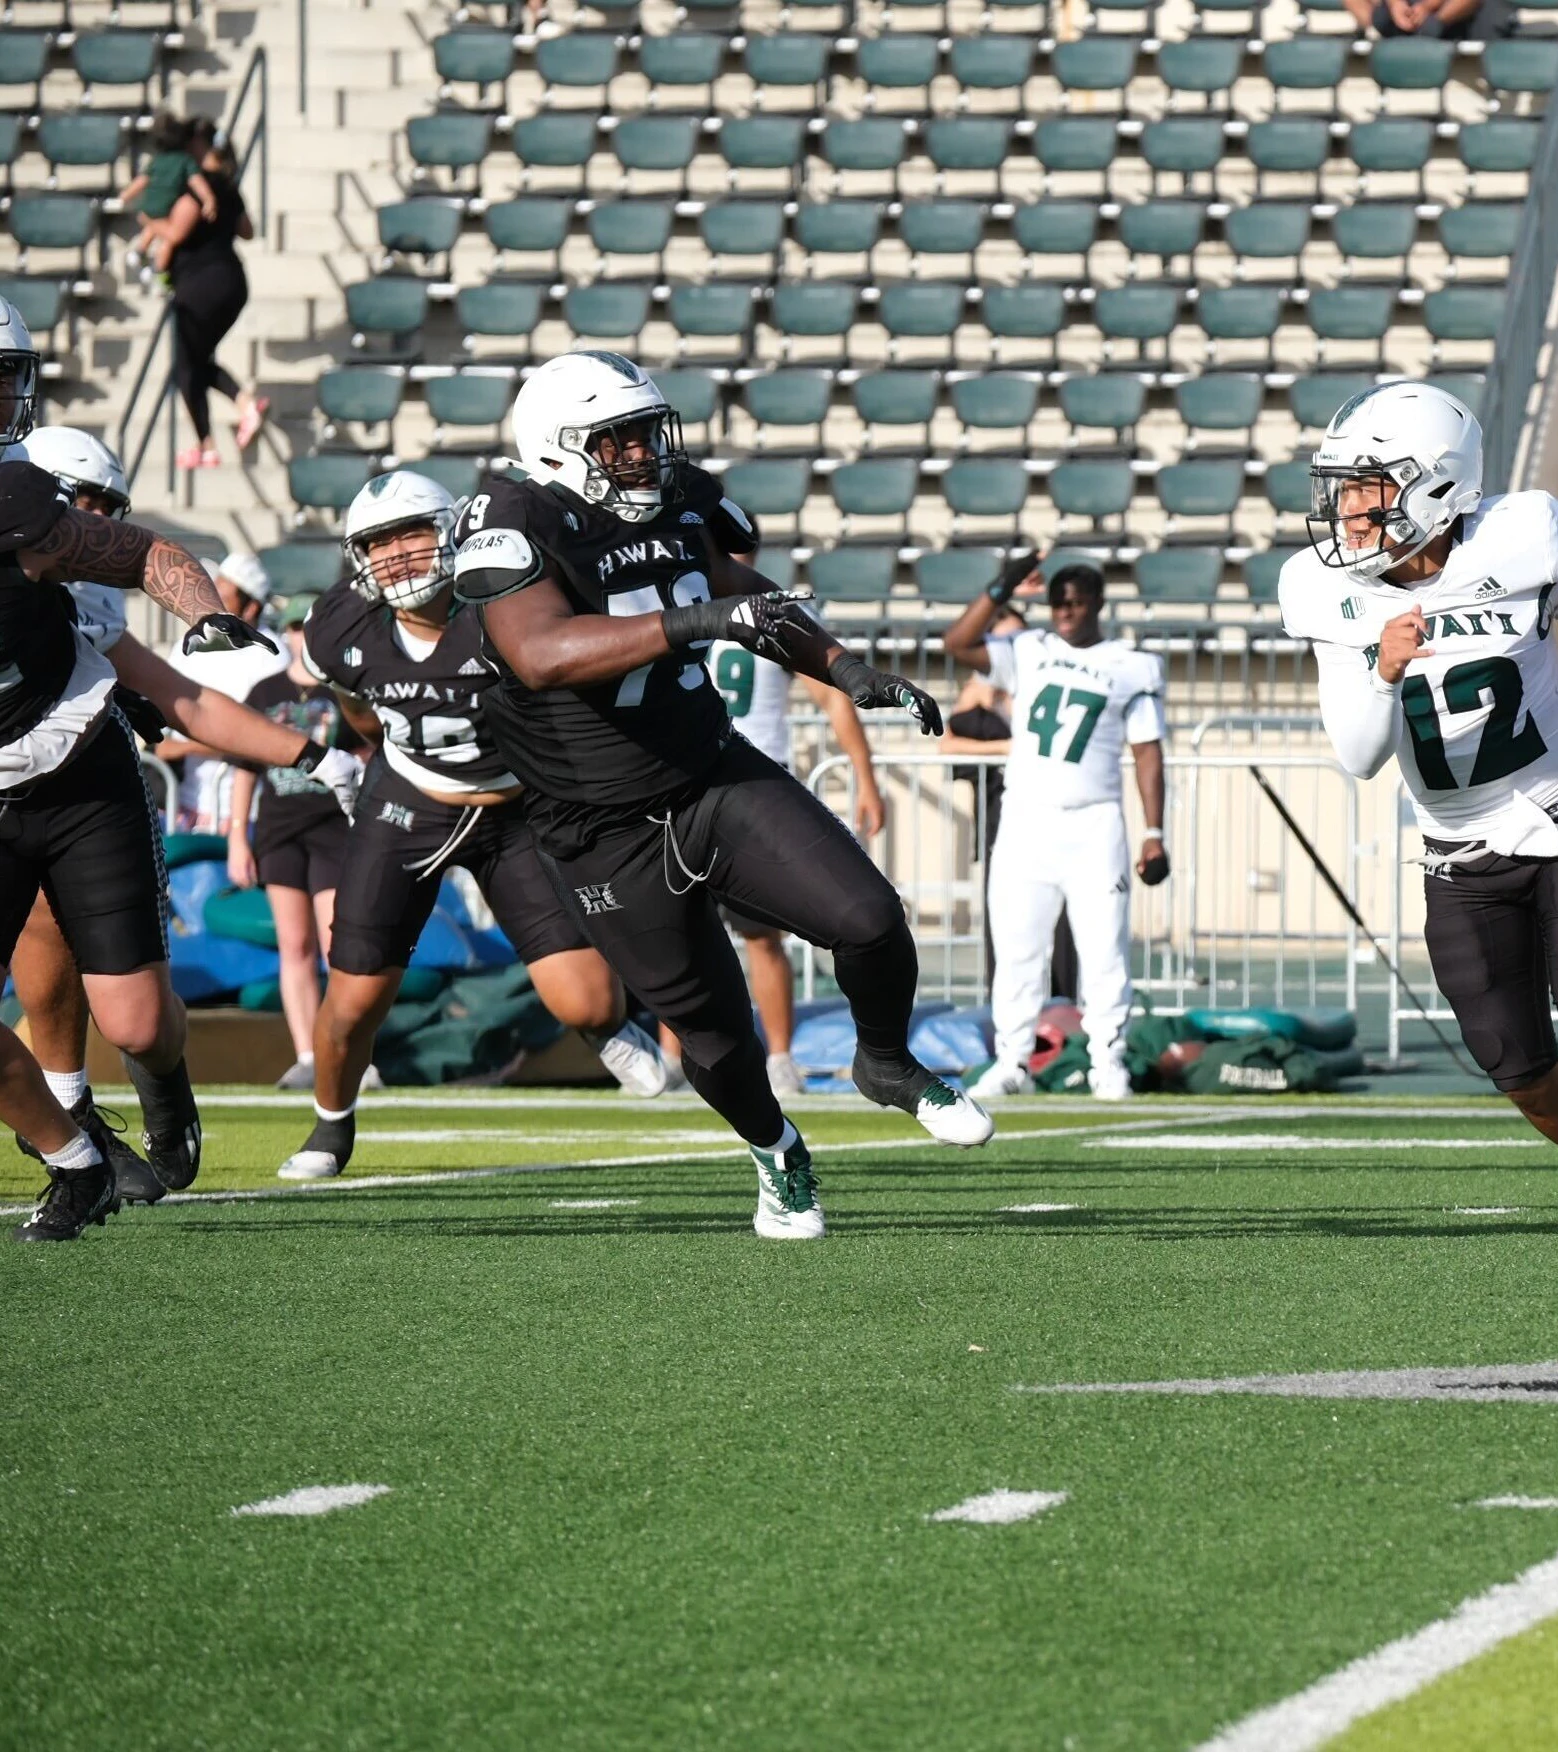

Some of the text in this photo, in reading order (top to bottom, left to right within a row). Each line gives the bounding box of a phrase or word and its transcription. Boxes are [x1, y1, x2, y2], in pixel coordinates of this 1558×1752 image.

[458, 534, 508, 556] OUGLAS
[1474, 586, 1509, 600] adidas
[1027, 683, 1109, 764] 47
[1401, 656, 1549, 791] 12
